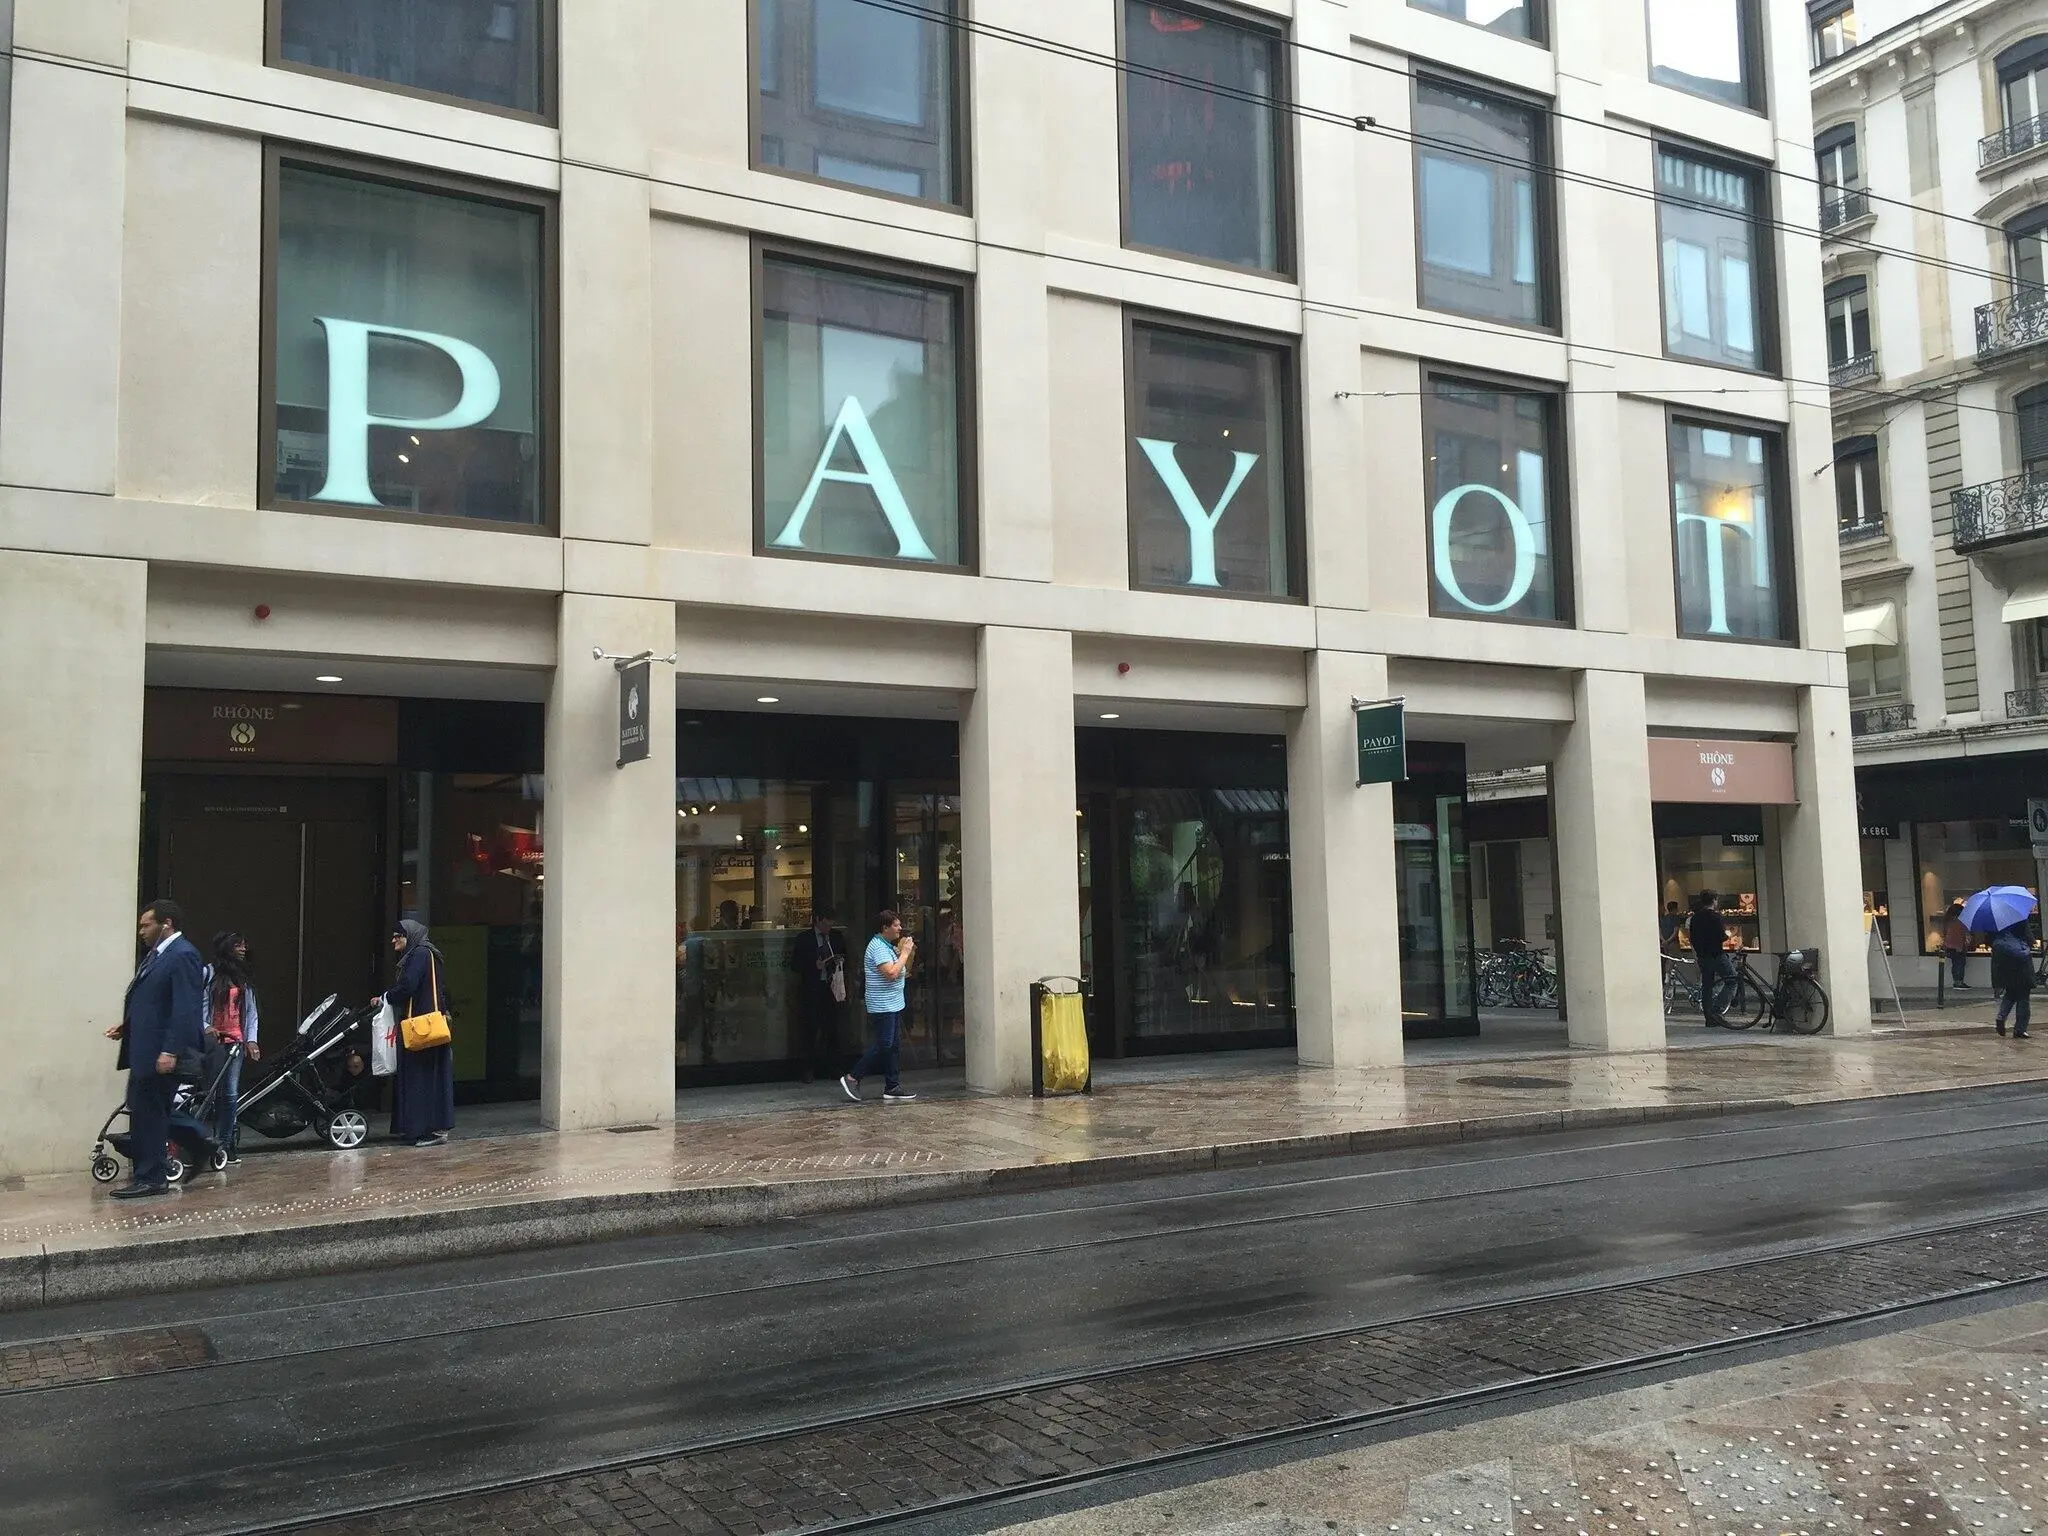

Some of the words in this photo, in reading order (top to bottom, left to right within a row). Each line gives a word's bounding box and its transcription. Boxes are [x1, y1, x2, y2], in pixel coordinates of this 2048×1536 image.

[308, 316, 1753, 637] PAYOT
[212, 704, 274, 719] RHÔNE
[1363, 735, 1397, 748] PAYOT
[1700, 750, 1734, 764] RHÔNE
[1731, 834, 1759, 843] TISSOT
